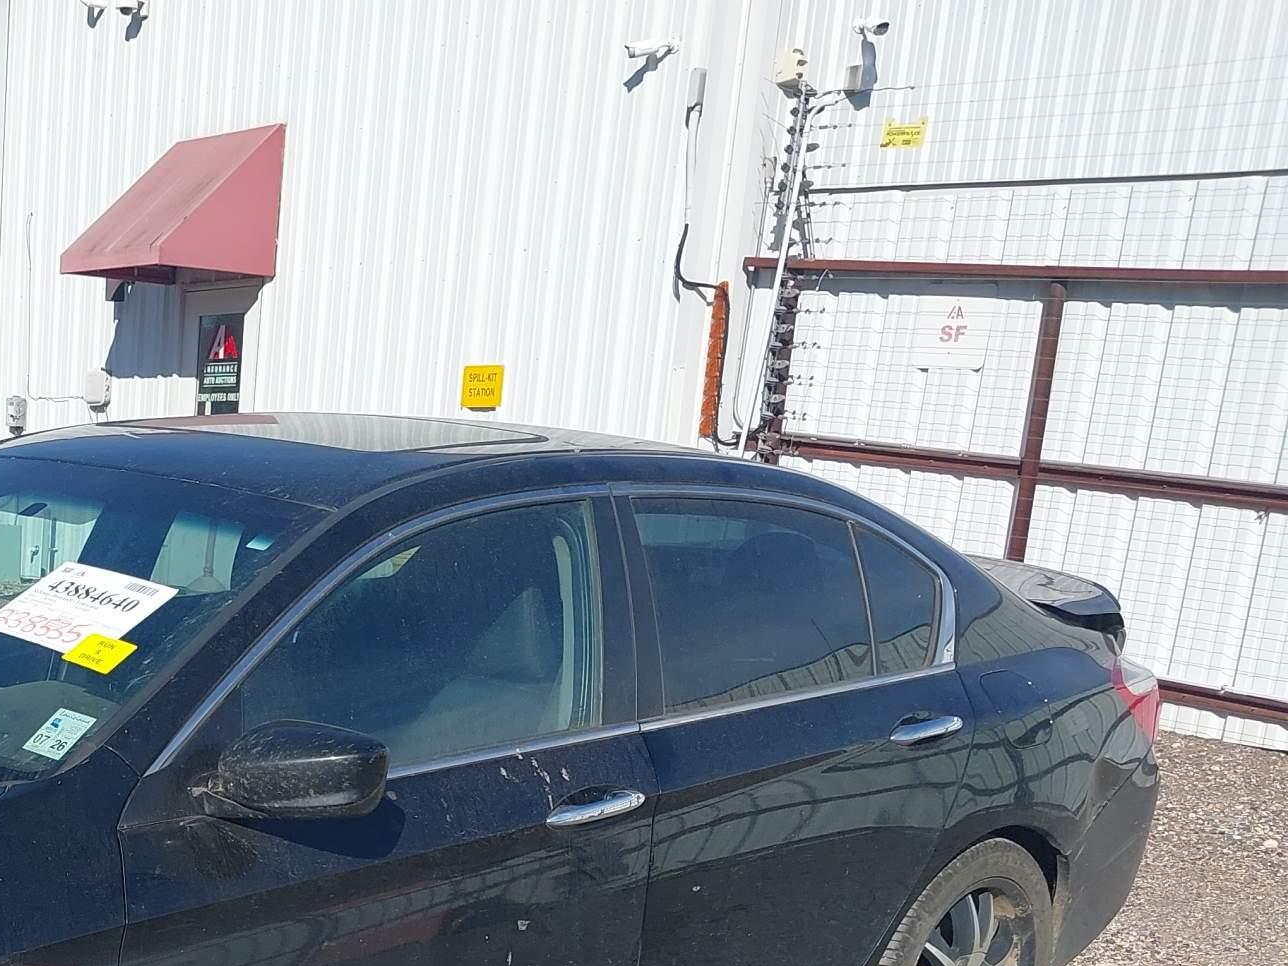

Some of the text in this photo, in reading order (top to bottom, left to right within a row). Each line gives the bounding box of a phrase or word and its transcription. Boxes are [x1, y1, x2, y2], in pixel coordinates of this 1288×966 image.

[939, 325, 968, 342] SF
[203, 376, 215, 385] AUTO
[468, 372, 498, 383] SPILL-KIT
[198, 392, 226, 402] EMPLOYEES
[468, 387, 496, 398] STATION
[48, 580, 140, 613] 43884640
[97, 640, 116, 650] RUN
[78, 652, 104, 664] DRIVE
[33, 733, 68, 751] 07 26
